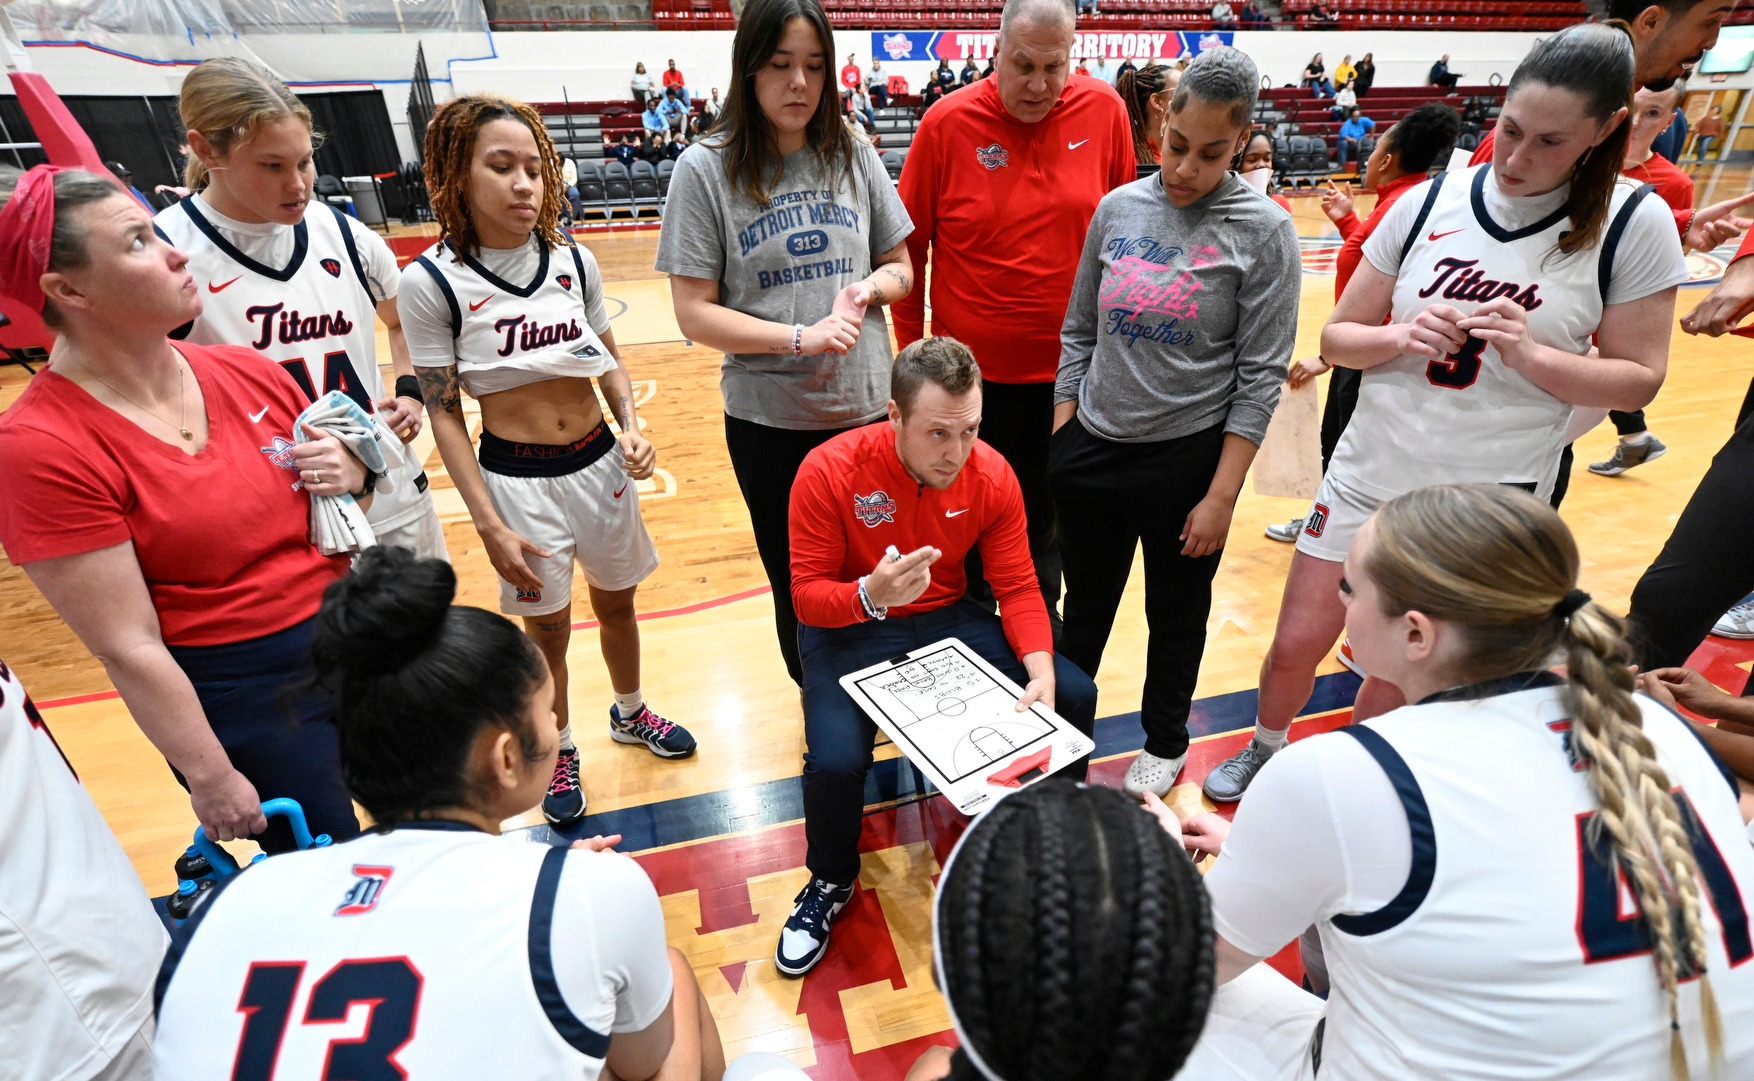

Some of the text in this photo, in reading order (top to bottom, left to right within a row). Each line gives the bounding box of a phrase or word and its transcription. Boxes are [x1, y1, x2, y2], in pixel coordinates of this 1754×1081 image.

[956, 33, 1167, 59] TIT RRITORY
[760, 190, 818, 213] ROPERTY
[738, 202, 860, 257] DETROIT MERCY
[793, 234, 821, 252] 313
[1107, 236, 1184, 265] We Will
[757, 257, 854, 289] BASKETBALL
[1101, 256, 1202, 321] Fight
[1418, 257, 1543, 312] Titans
[246, 302, 353, 350] Titans
[494, 314, 583, 357] Titans
[1106, 308, 1194, 348] Together
[856, 501, 896, 517] TITANS
[230, 955, 425, 1081] 13
